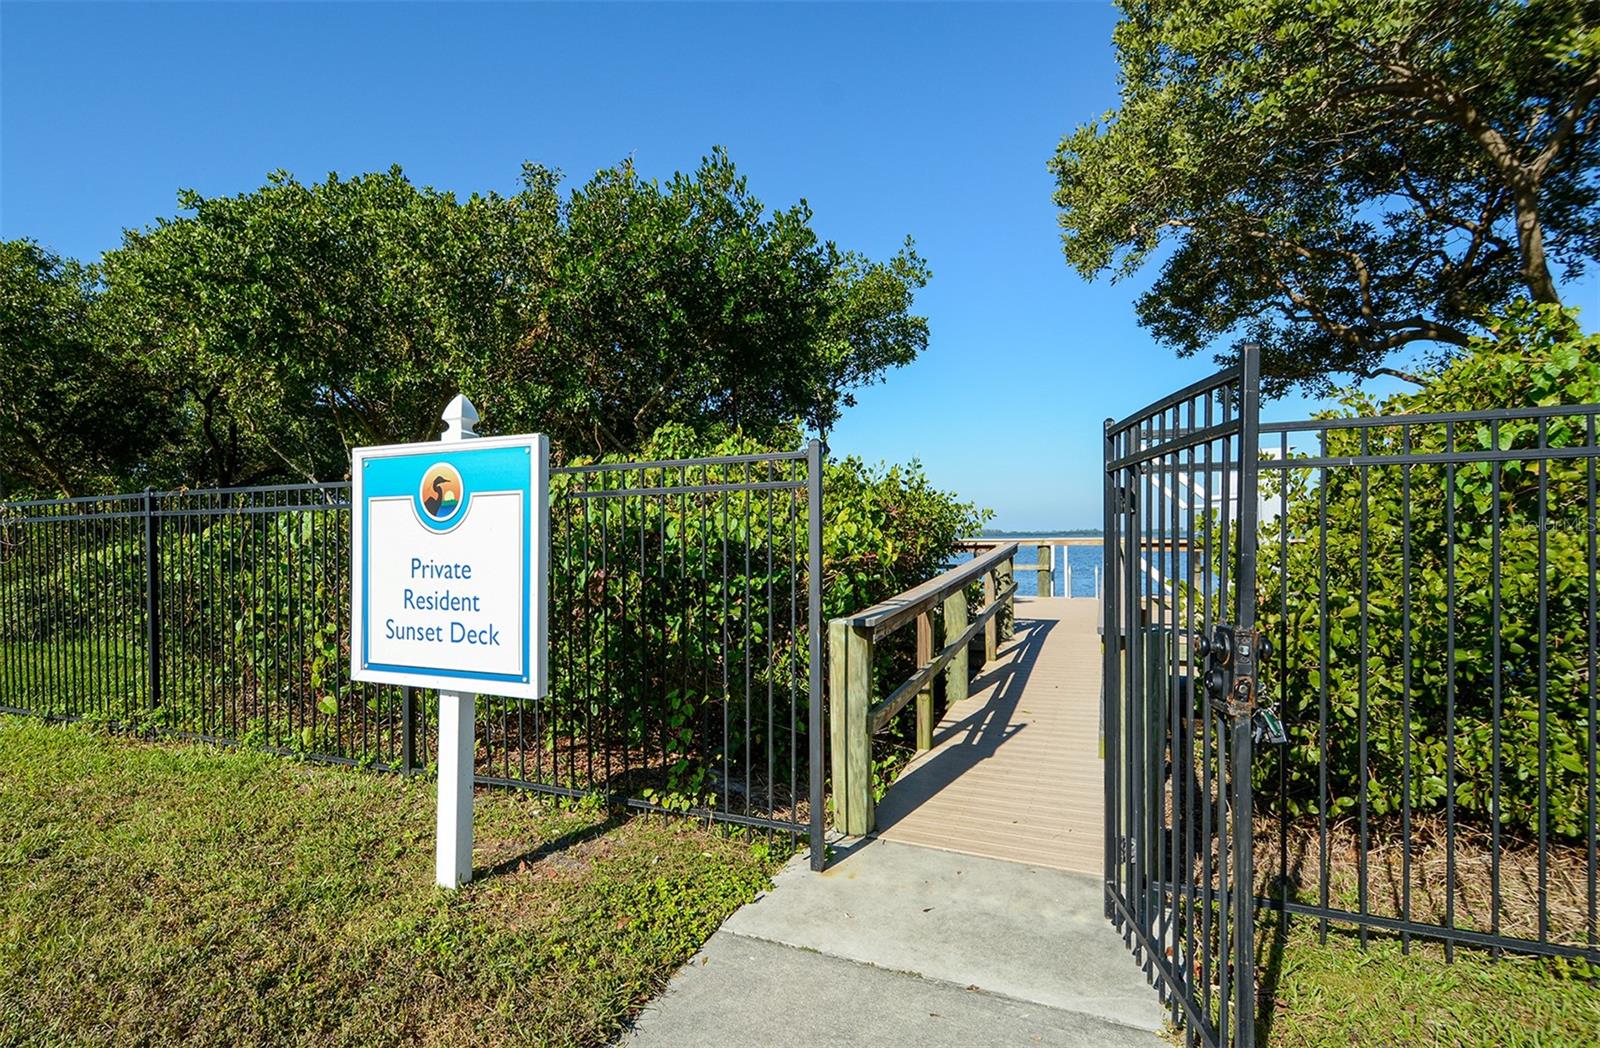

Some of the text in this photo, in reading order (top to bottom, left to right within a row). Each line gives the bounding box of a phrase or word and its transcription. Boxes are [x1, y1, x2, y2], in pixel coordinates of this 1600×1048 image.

[411, 557, 472, 579] Private
[404, 588, 480, 612] Resident
[385, 618, 500, 646] Sunset Deck
